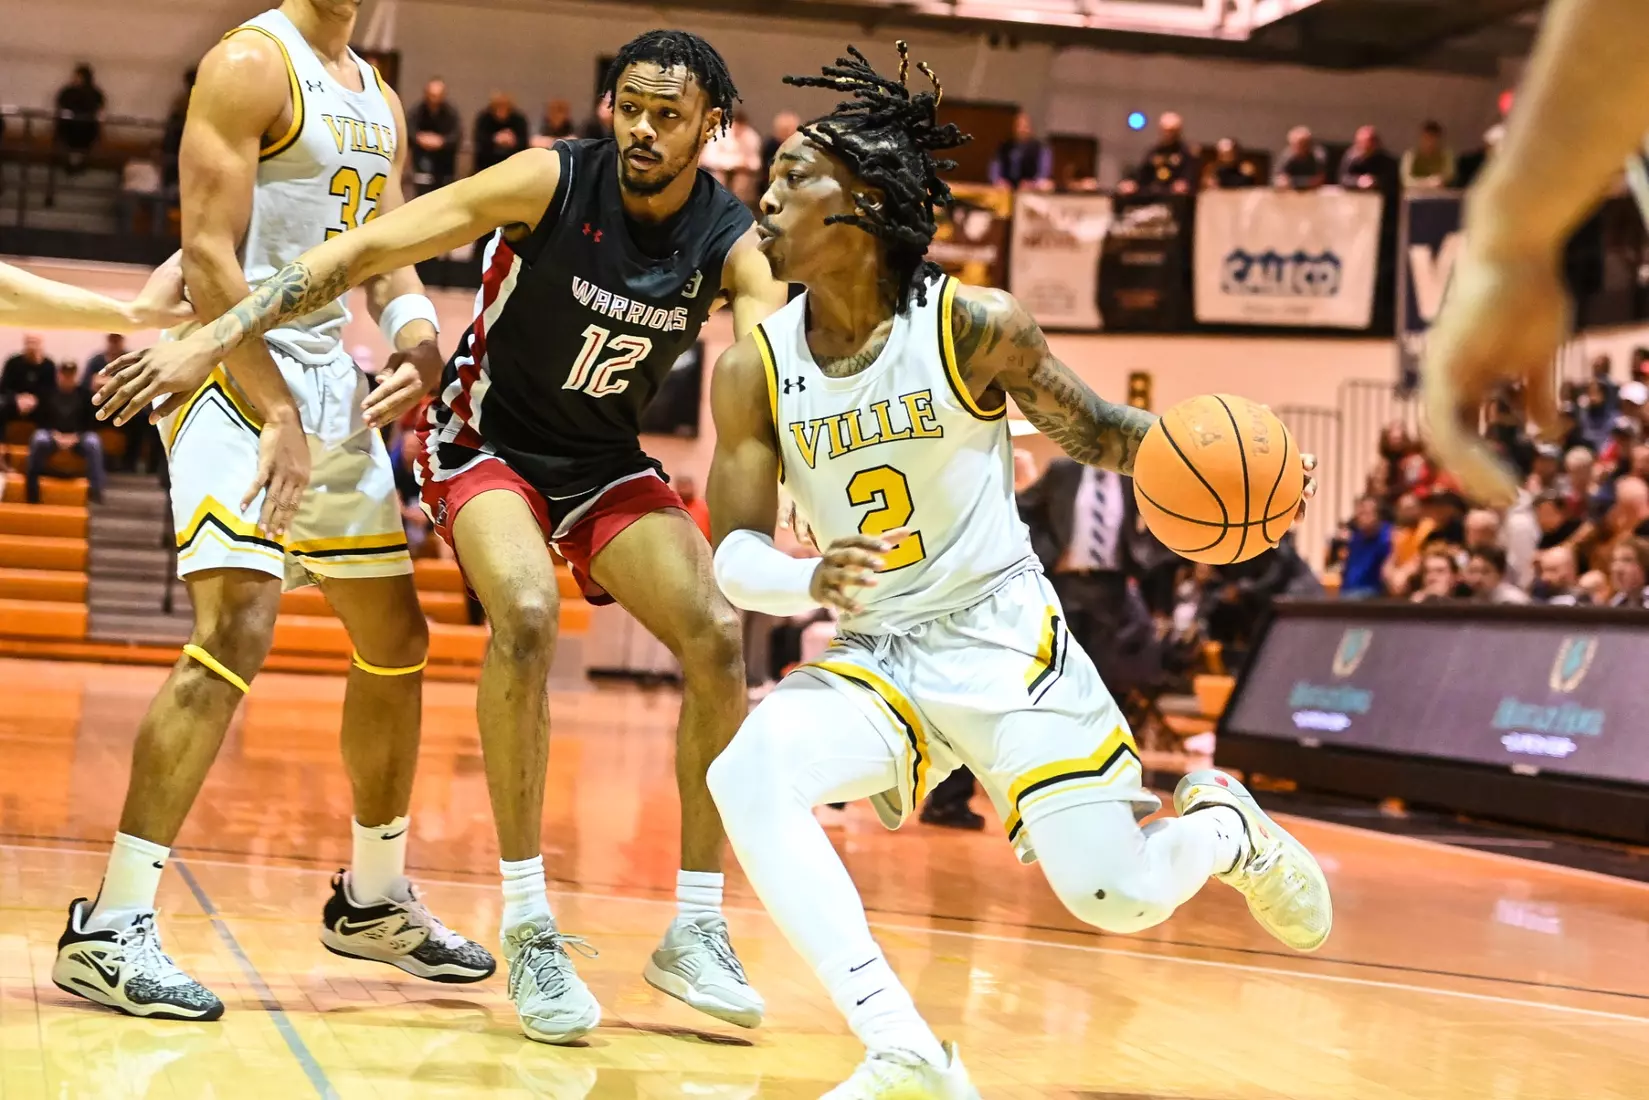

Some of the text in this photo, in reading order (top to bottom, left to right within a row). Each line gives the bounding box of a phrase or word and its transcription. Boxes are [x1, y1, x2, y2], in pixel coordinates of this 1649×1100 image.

[561, 324, 652, 398] 12
[789, 388, 944, 469] VILLE
[846, 463, 926, 573] 2
